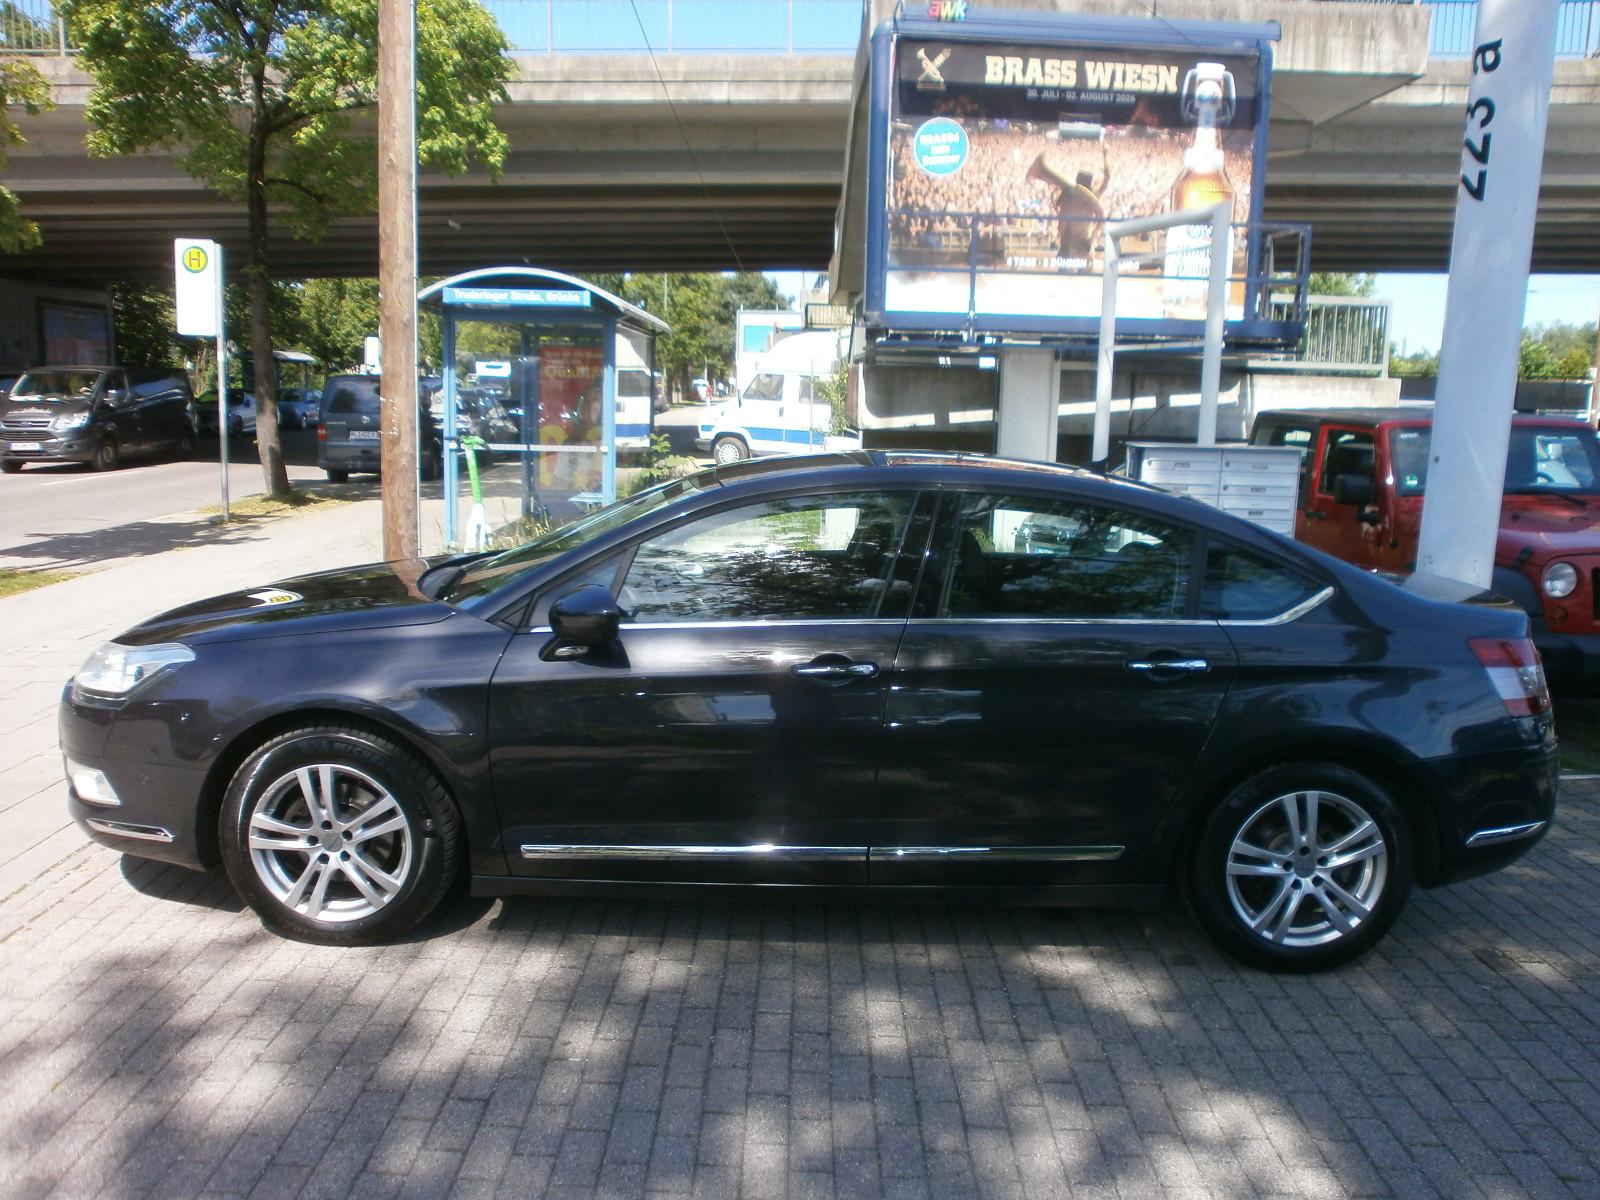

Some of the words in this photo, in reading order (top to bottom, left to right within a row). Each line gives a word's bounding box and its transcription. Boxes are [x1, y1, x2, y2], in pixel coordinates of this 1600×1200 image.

[928, 0, 968, 21] awk
[1473, 38, 1503, 76] a
[985, 55, 1077, 88] BRASS
[1084, 60, 1179, 95] WIESN
[1041, 88, 1060, 99] JULI
[1079, 90, 1114, 102] AUGUST
[188, 251, 200, 268] H
[454, 287, 509, 302] Truderinger
